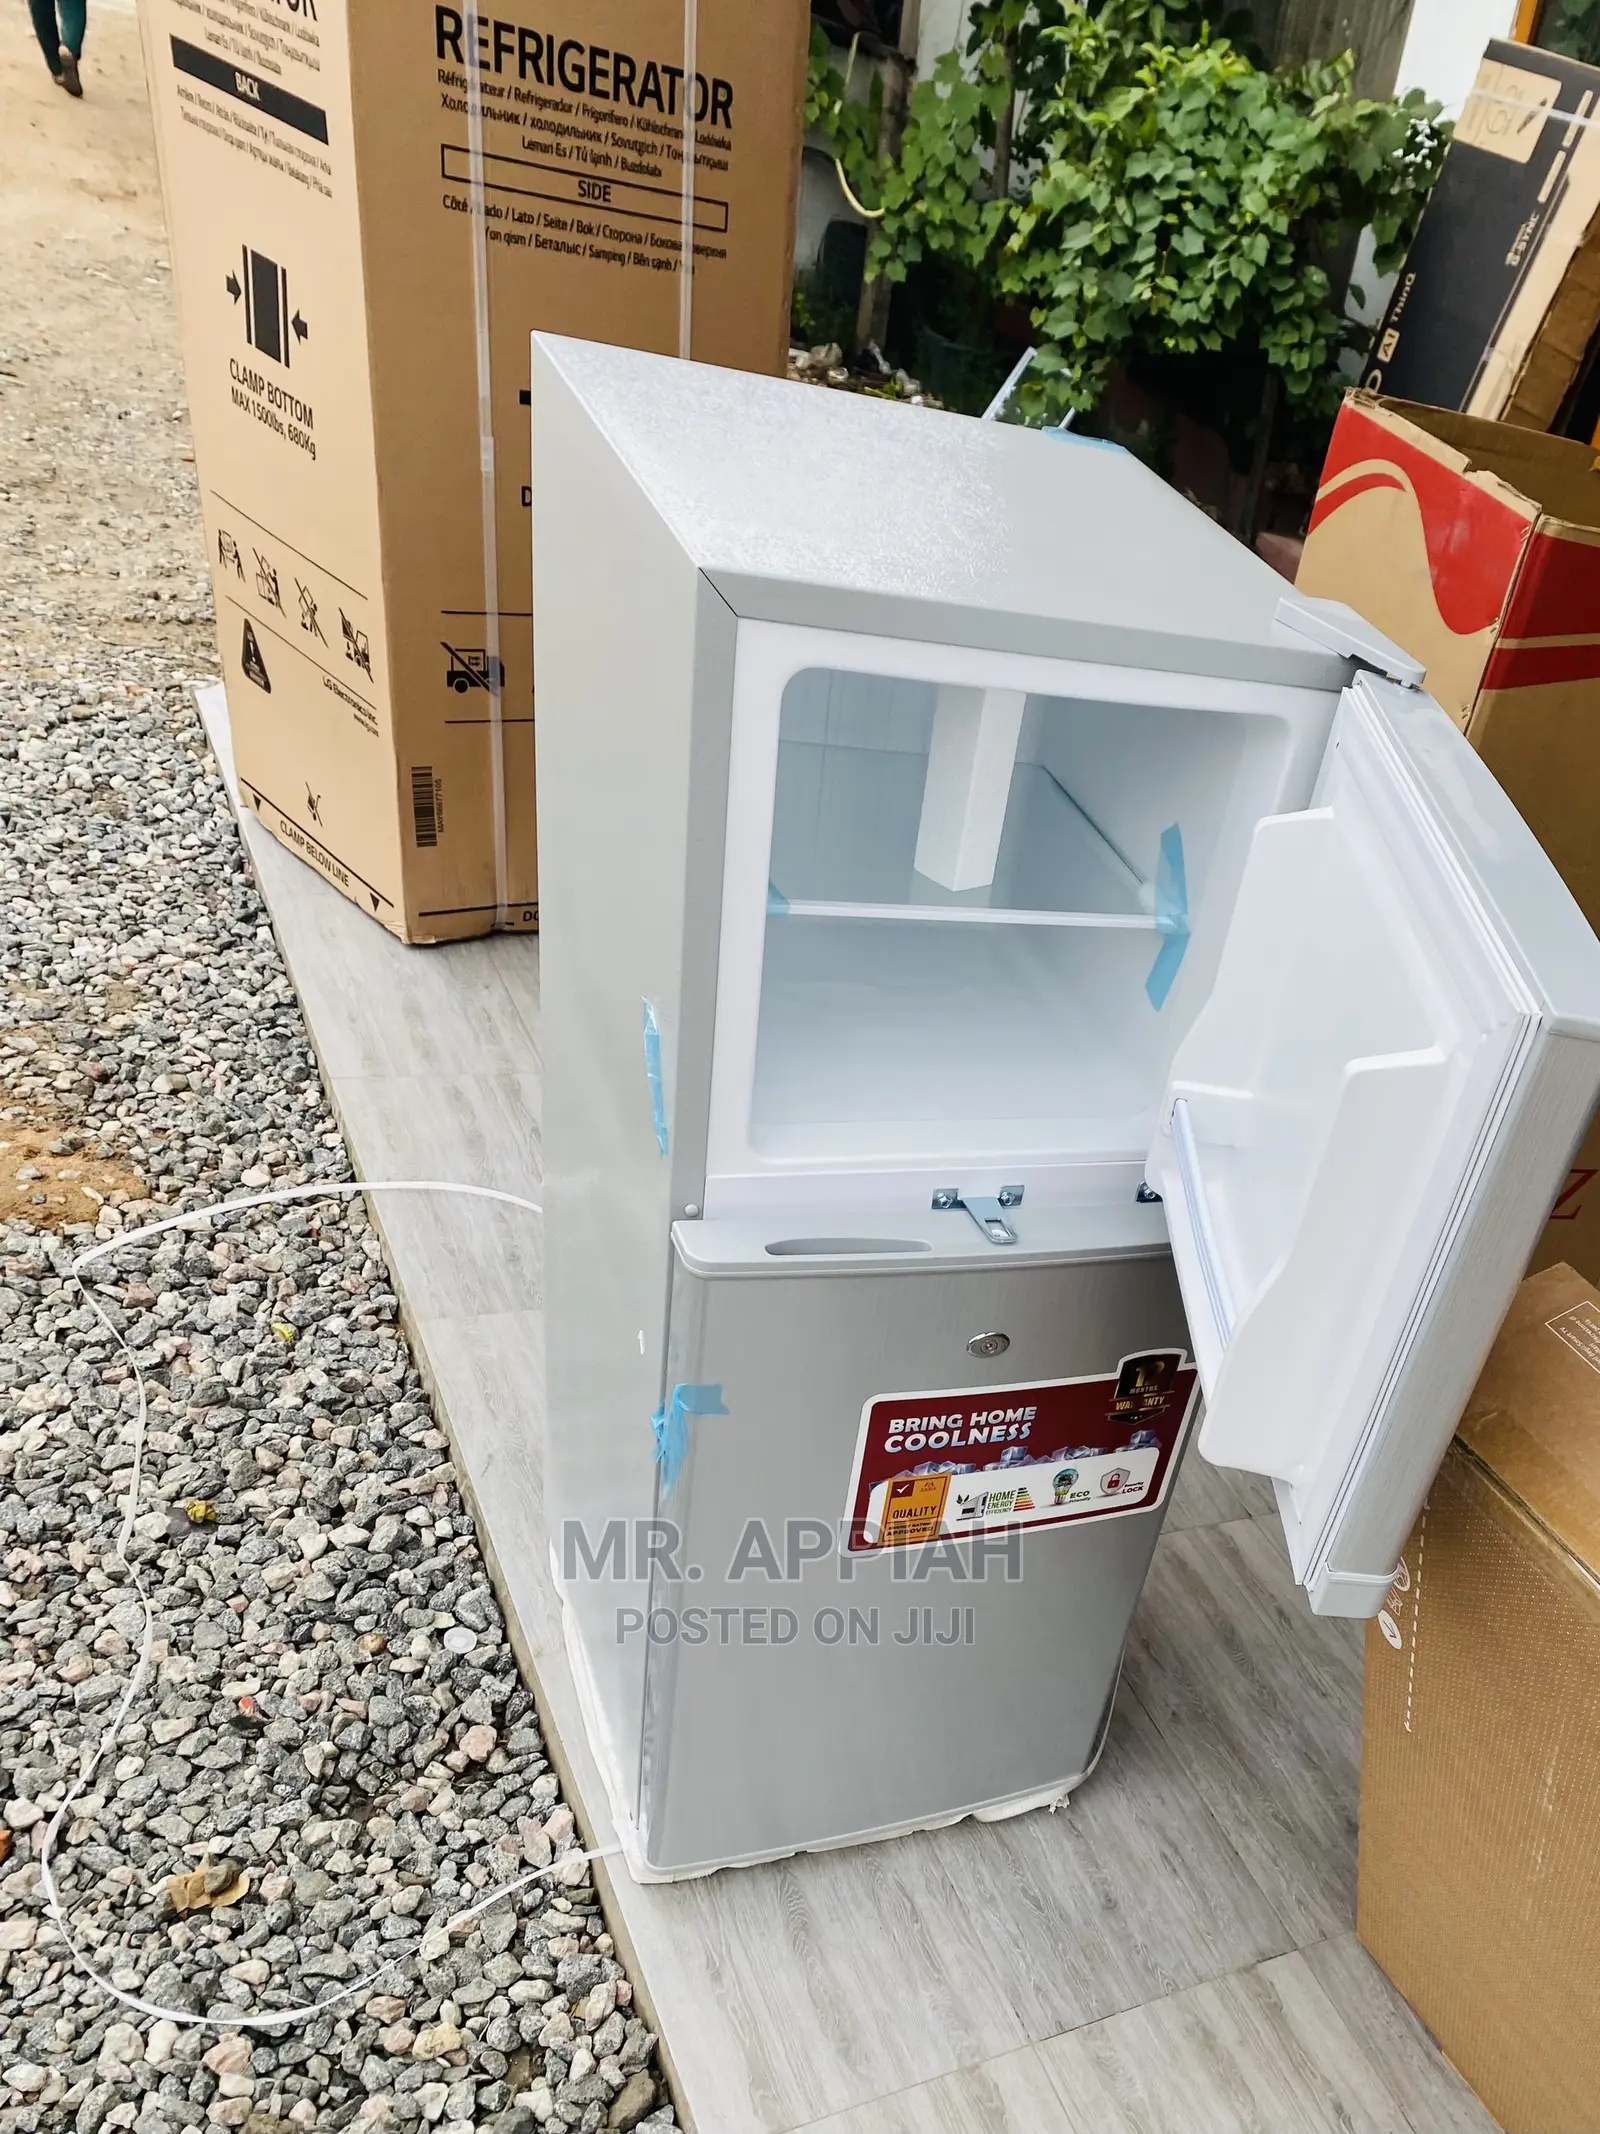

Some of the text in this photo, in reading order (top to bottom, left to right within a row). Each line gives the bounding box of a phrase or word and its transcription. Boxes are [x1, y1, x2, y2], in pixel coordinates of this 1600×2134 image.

[435, 5, 733, 129] REFRIGERATOR
[234, 71, 261, 101] BACK
[438, 68, 505, 98] Réfrigateur
[637, 117, 684, 139] Kühlschran
[578, 180, 611, 202] SIDE
[512, 208, 534, 224] Lato
[1390, 272, 1416, 323] ThinQ
[229, 358, 314, 430] CLAMP BOTTOM
[231, 385, 251, 414] MAX
[280, 820, 349, 888] CLAMP BELOW LINE
[888, 1406, 1037, 1434] BRING HOME
[884, 1421, 1032, 1453] COOLNESS
[989, 1490, 1017, 1502] HOME
[1069, 1490, 1090, 1499] ECO
[1121, 1485, 1144, 1494] LOCK
[892, 1505, 937, 1519] QUALITY
[986, 1500, 1014, 1510] ENERGY
[886, 1526, 934, 1536] APPROVED
